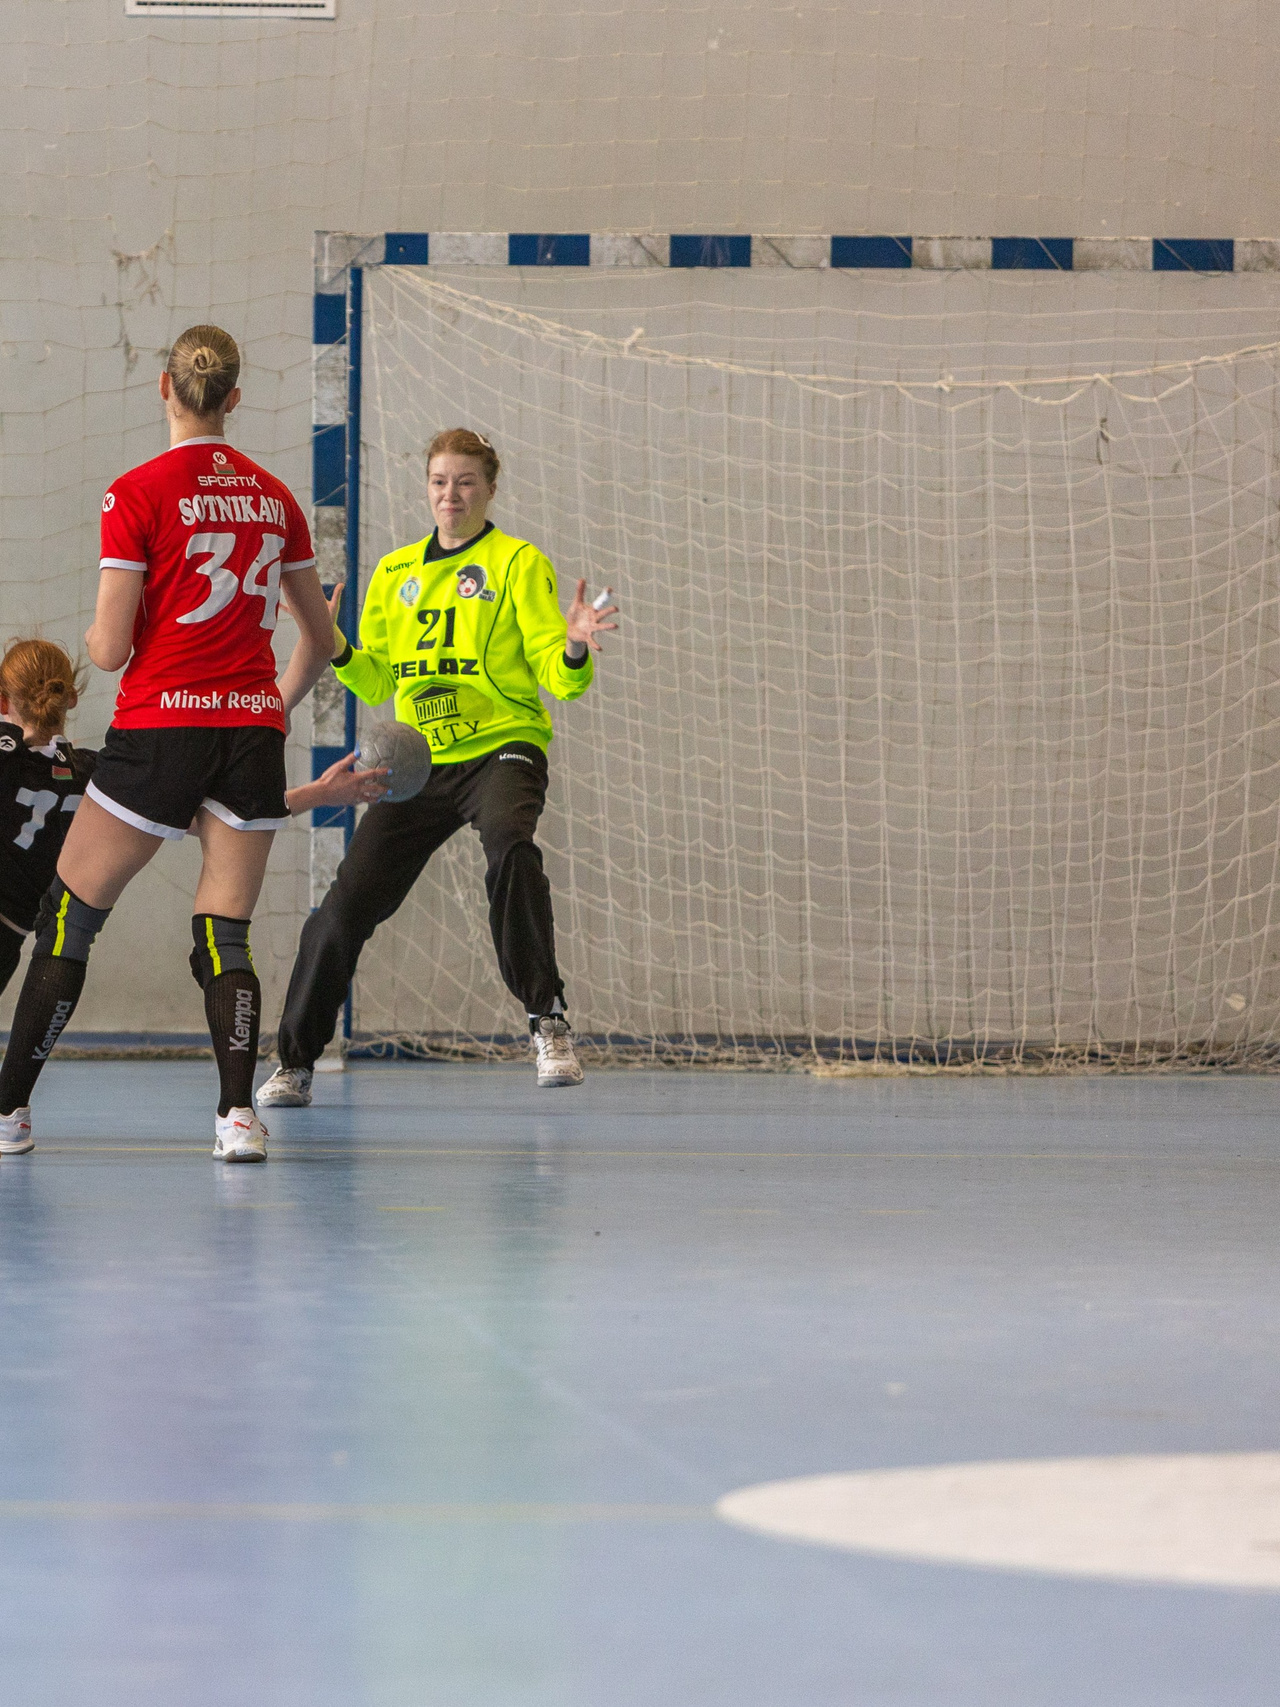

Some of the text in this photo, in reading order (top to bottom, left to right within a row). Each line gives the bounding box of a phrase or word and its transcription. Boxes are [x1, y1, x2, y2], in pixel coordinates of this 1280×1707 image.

[197, 474, 263, 490] SPORTIX
[178, 494, 287, 530] SOTNIKAVA
[176, 532, 285, 630] 34
[385, 559, 417, 574] Kemp
[416, 607, 456, 651] 21
[392, 658, 479, 680] BELAZ
[160, 690, 282, 714] Minsk Region
[32, 1001, 72, 1060] Kempa
[230, 988, 253, 1051] Kempa
